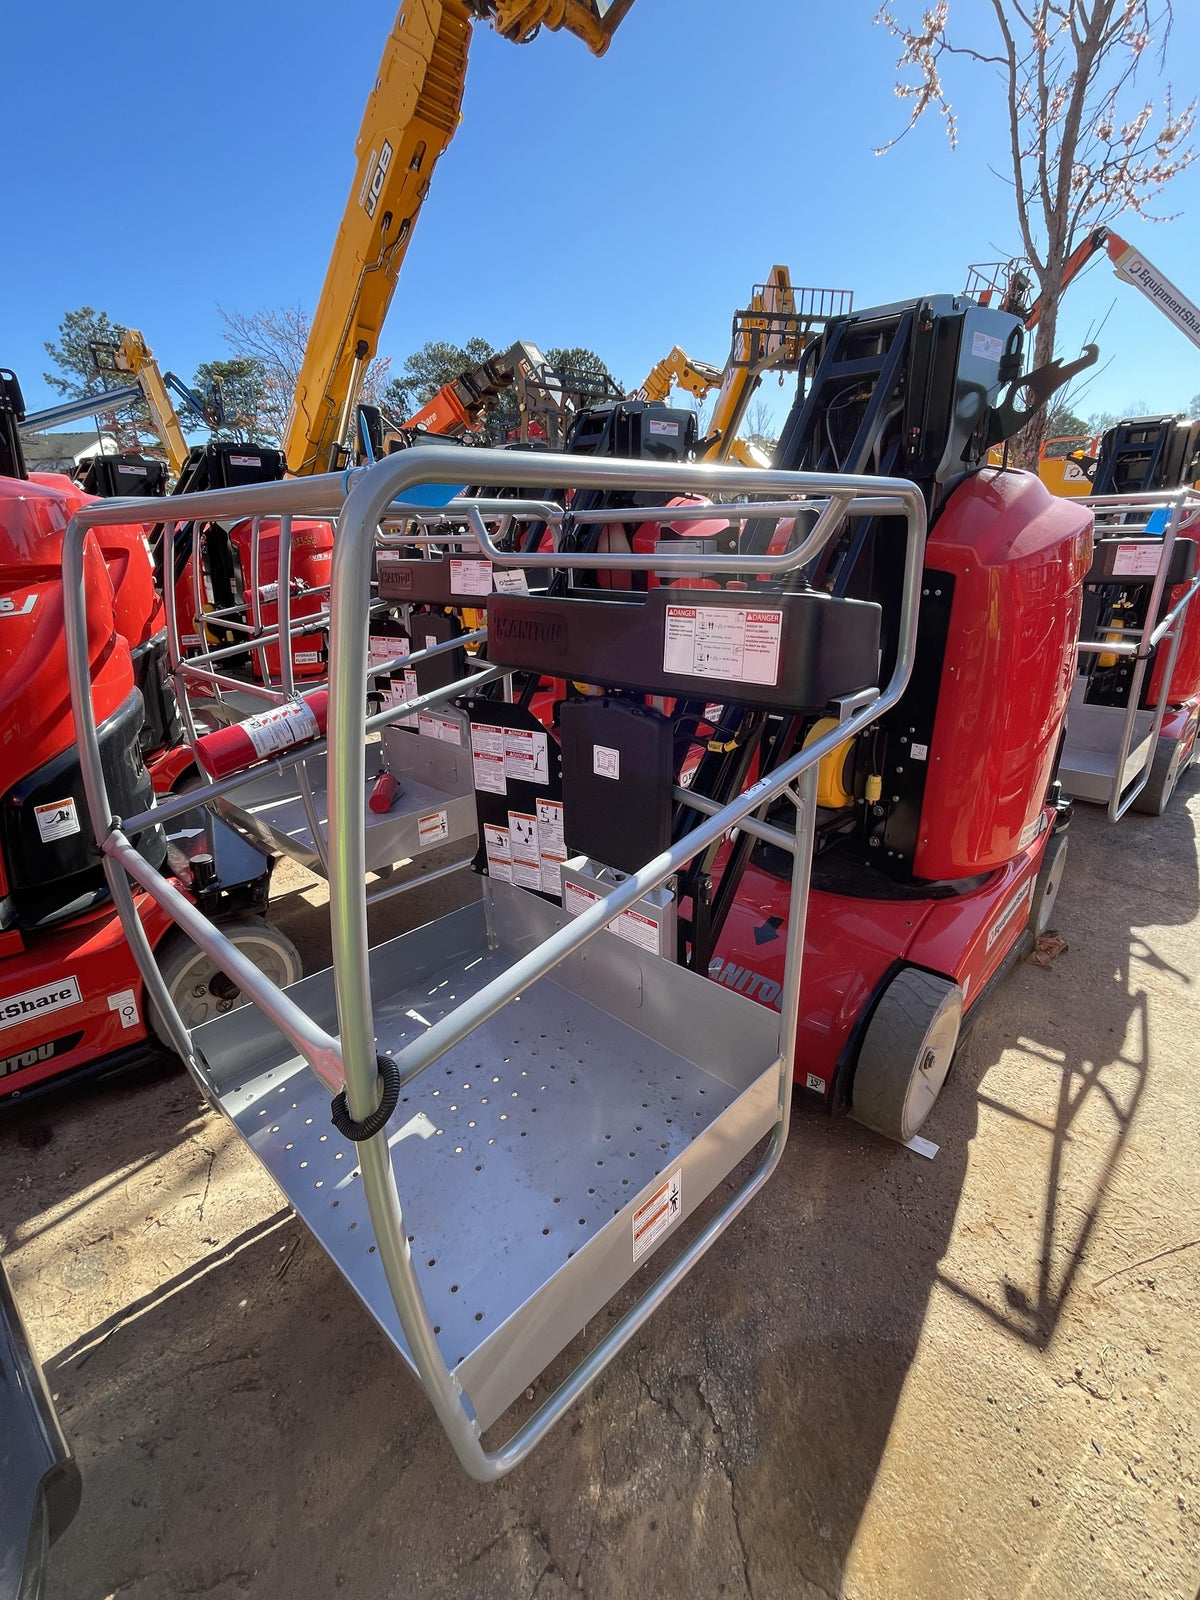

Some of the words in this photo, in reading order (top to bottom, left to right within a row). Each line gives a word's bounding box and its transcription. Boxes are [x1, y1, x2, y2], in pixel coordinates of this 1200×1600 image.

[367, 141, 393, 218] JCB
[673, 608, 696, 618] DANGER
[752, 613, 779, 623] DANGER
